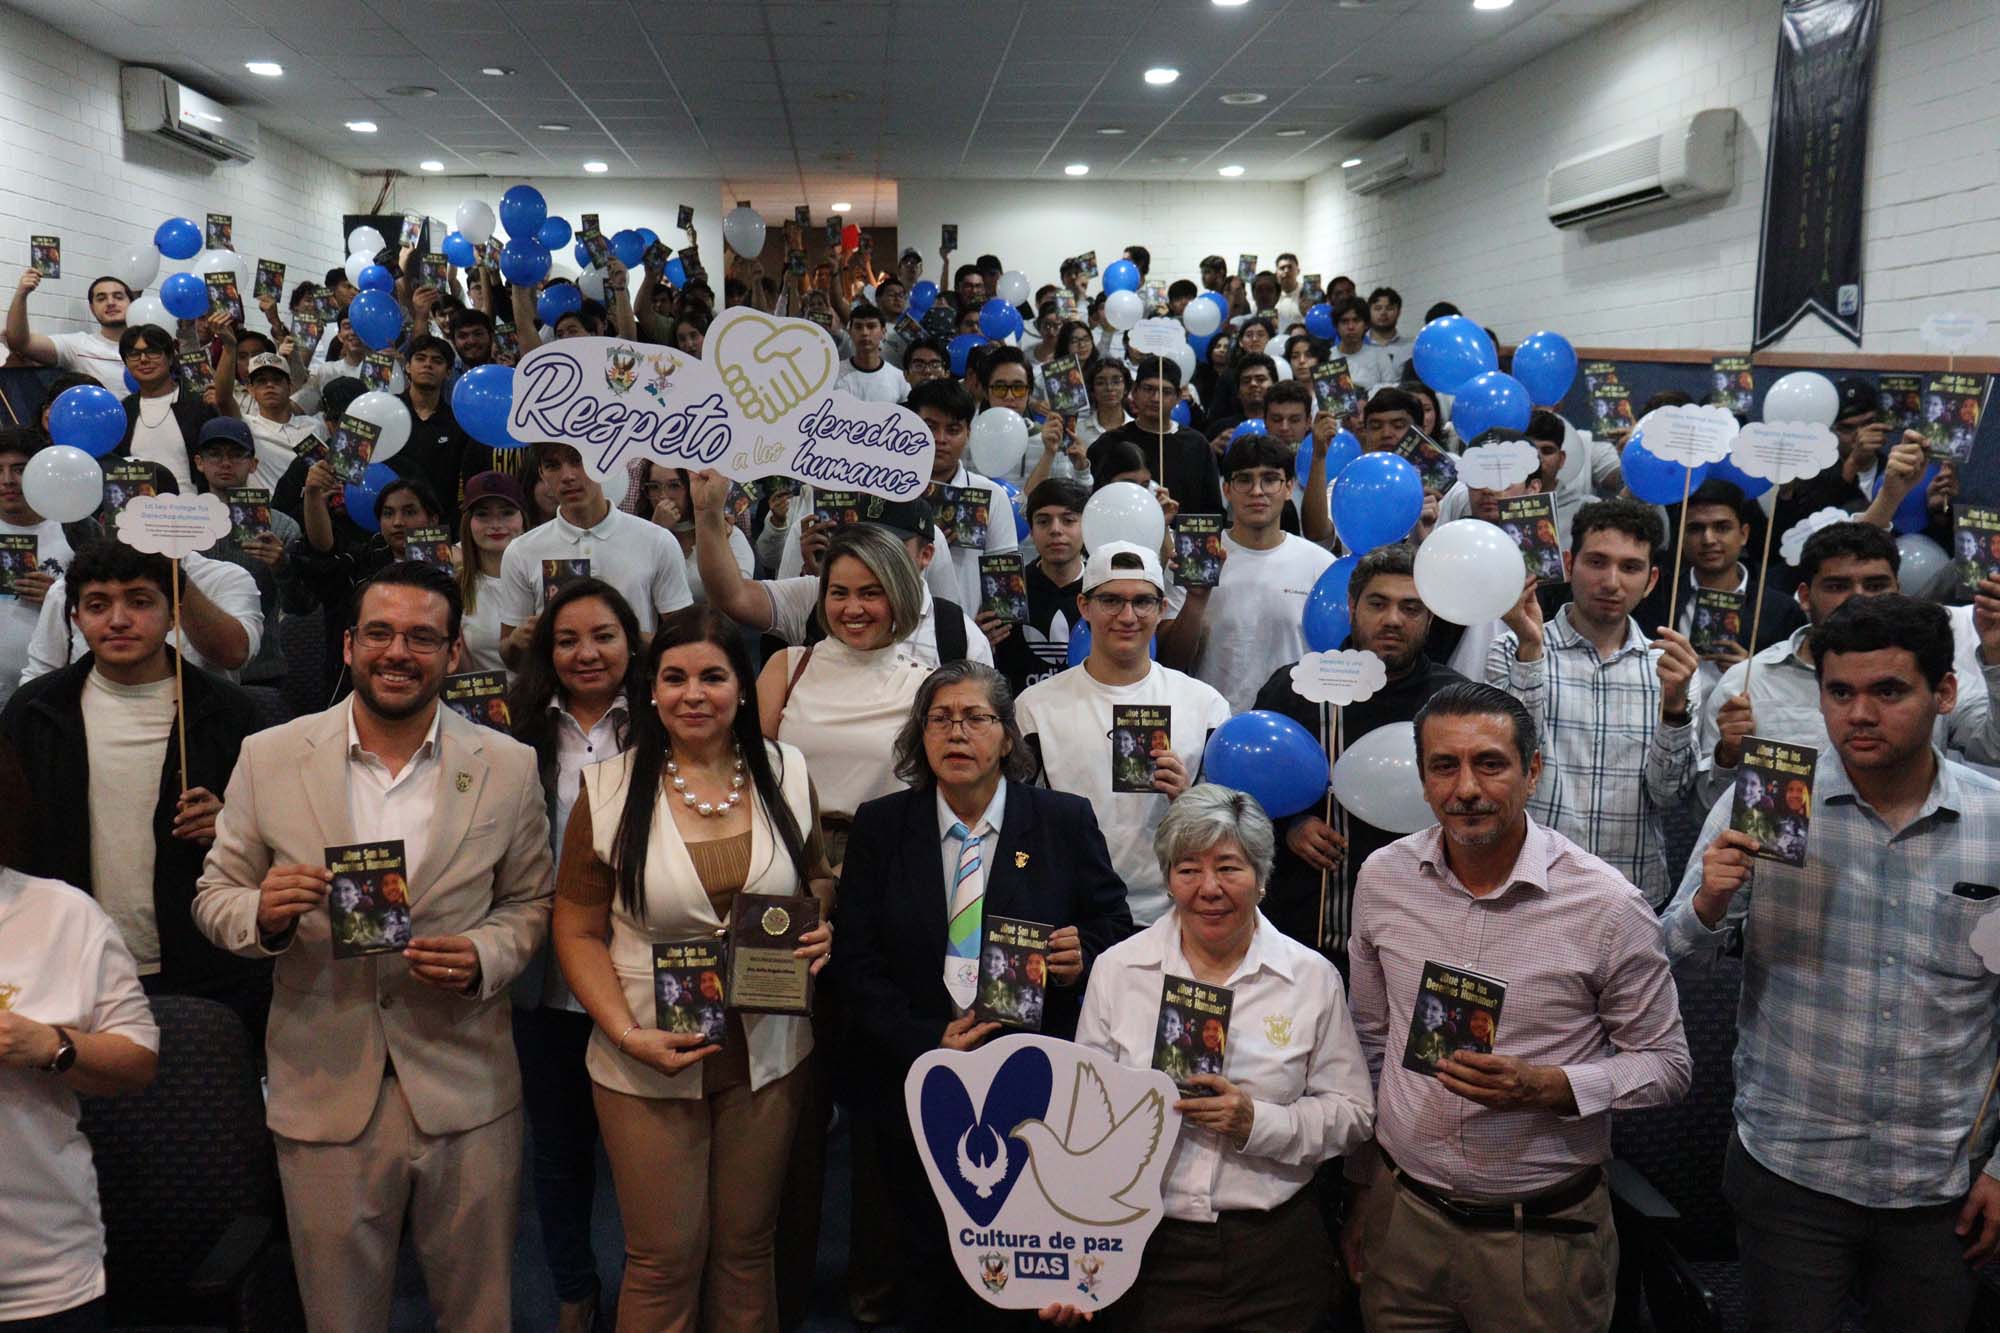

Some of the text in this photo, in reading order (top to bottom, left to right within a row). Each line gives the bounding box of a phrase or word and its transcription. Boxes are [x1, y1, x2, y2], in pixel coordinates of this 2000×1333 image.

[515, 353, 732, 473] Respeto
[800, 399, 930, 456] derechos
[732, 436, 783, 469] a los
[792, 440, 920, 494] humanos
[959, 1228, 1124, 1254] Cultura de paz
[1018, 1255, 1065, 1276] UAS
